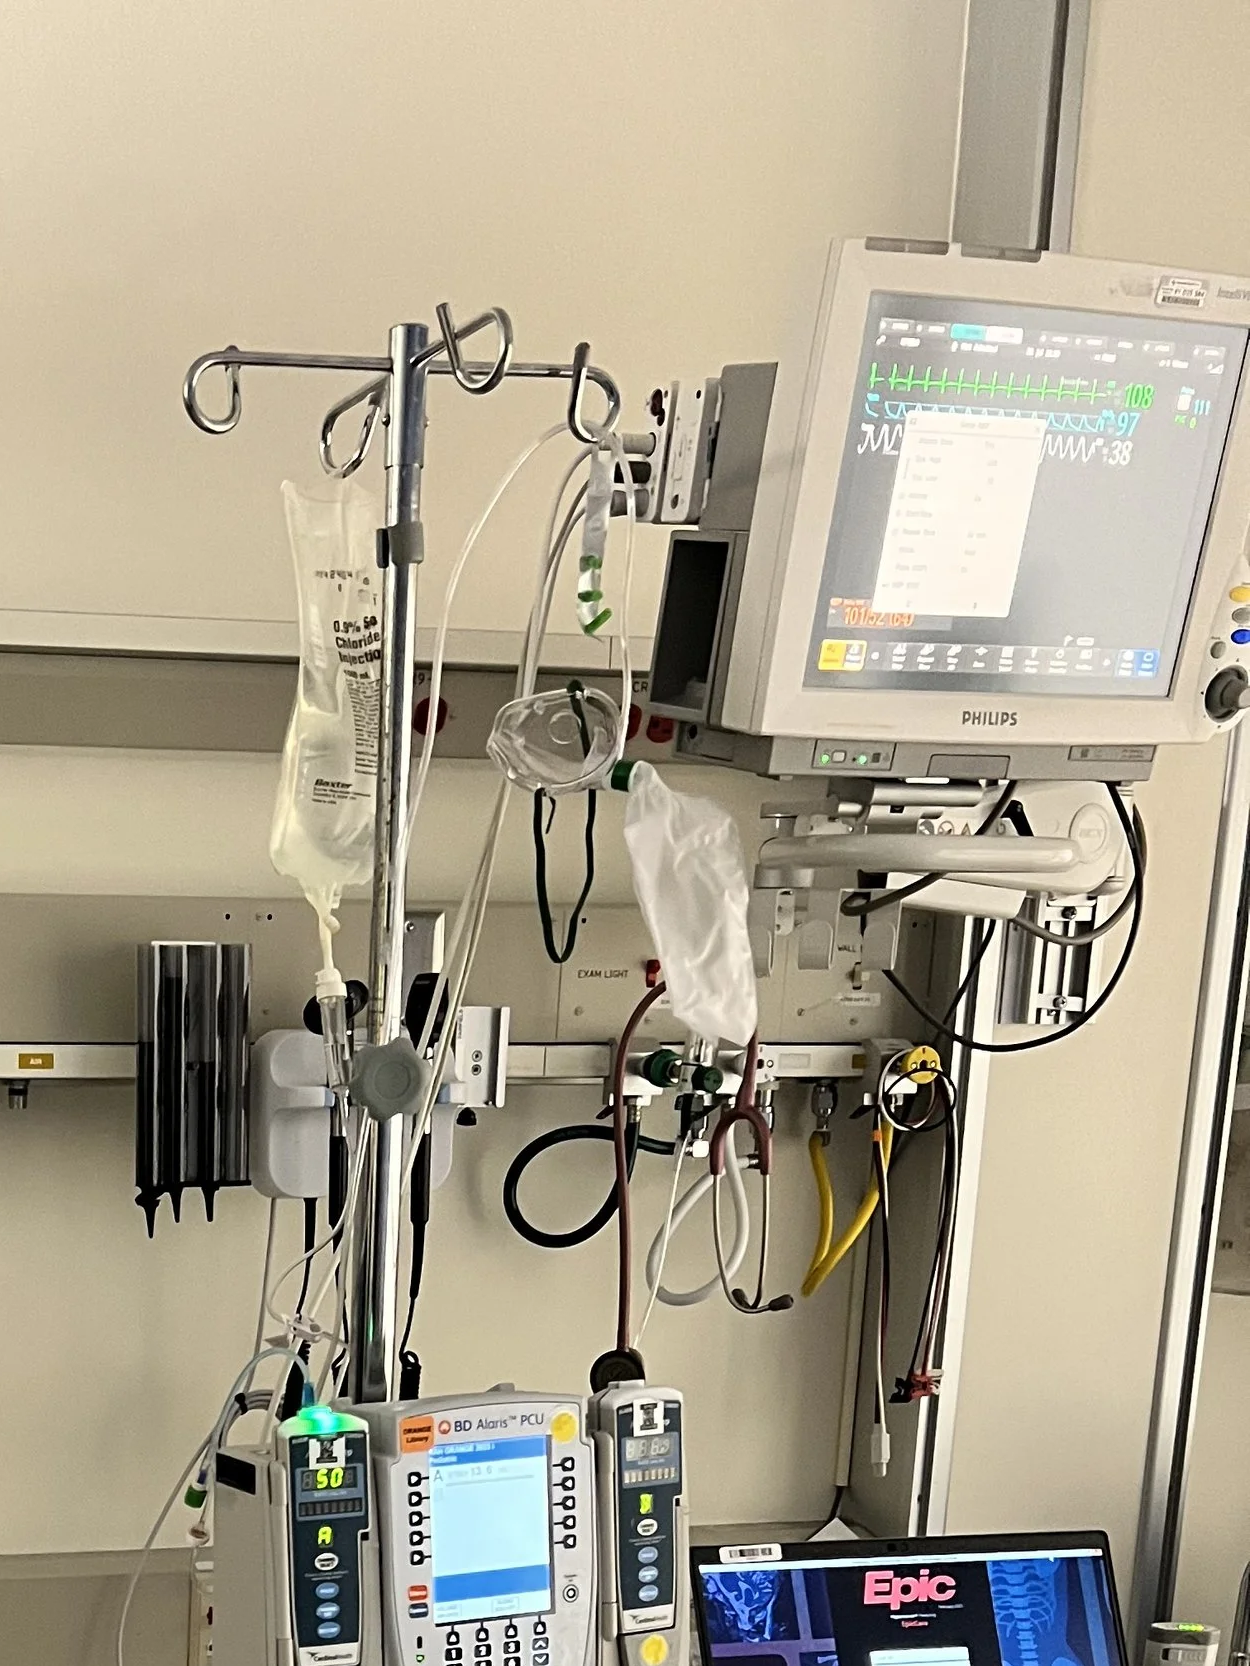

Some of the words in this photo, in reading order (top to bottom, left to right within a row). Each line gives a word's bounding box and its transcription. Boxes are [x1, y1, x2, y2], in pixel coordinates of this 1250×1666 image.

[1124, 383, 1155, 410] 108
[1116, 412, 1141, 437] 97
[1108, 440, 1133, 465] 38
[335, 631, 381, 649] Chloride
[338, 649, 382, 666] Injectio
[962, 710, 1018, 727] PHILIPS
[314, 778, 353, 789] Baxter
[577, 969, 602, 979] EXAM
[603, 969, 629, 979] LIGHT
[29, 1058, 43, 1066] AIR
[454, 1419, 473, 1433] BD
[520, 1413, 544, 1426] PCU
[316, 1467, 344, 1489] 50
[318, 1526, 333, 1546] A
[863, 1568, 956, 1611] Epic
